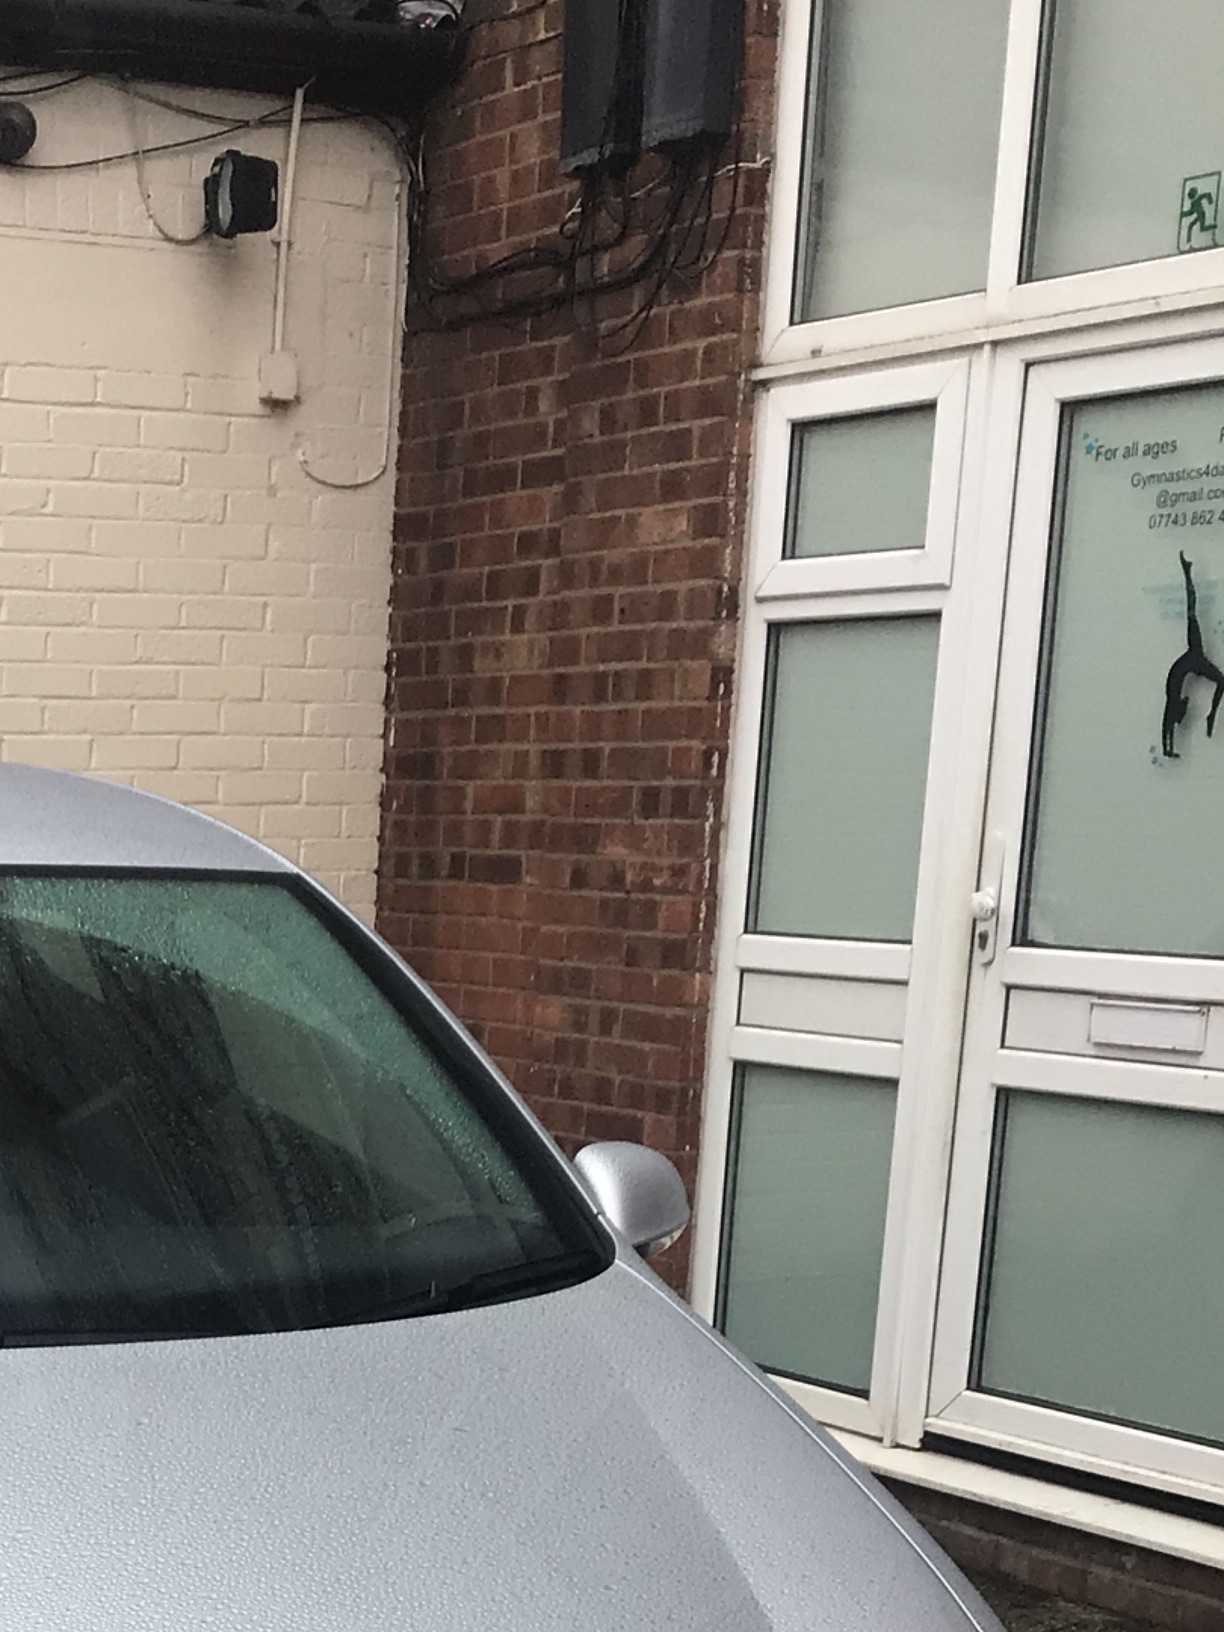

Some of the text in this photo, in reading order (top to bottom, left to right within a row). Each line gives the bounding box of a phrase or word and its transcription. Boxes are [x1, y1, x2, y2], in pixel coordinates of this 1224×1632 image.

[1094, 439, 1178, 462] For all ages
[1148, 511, 1187, 529] 07743
